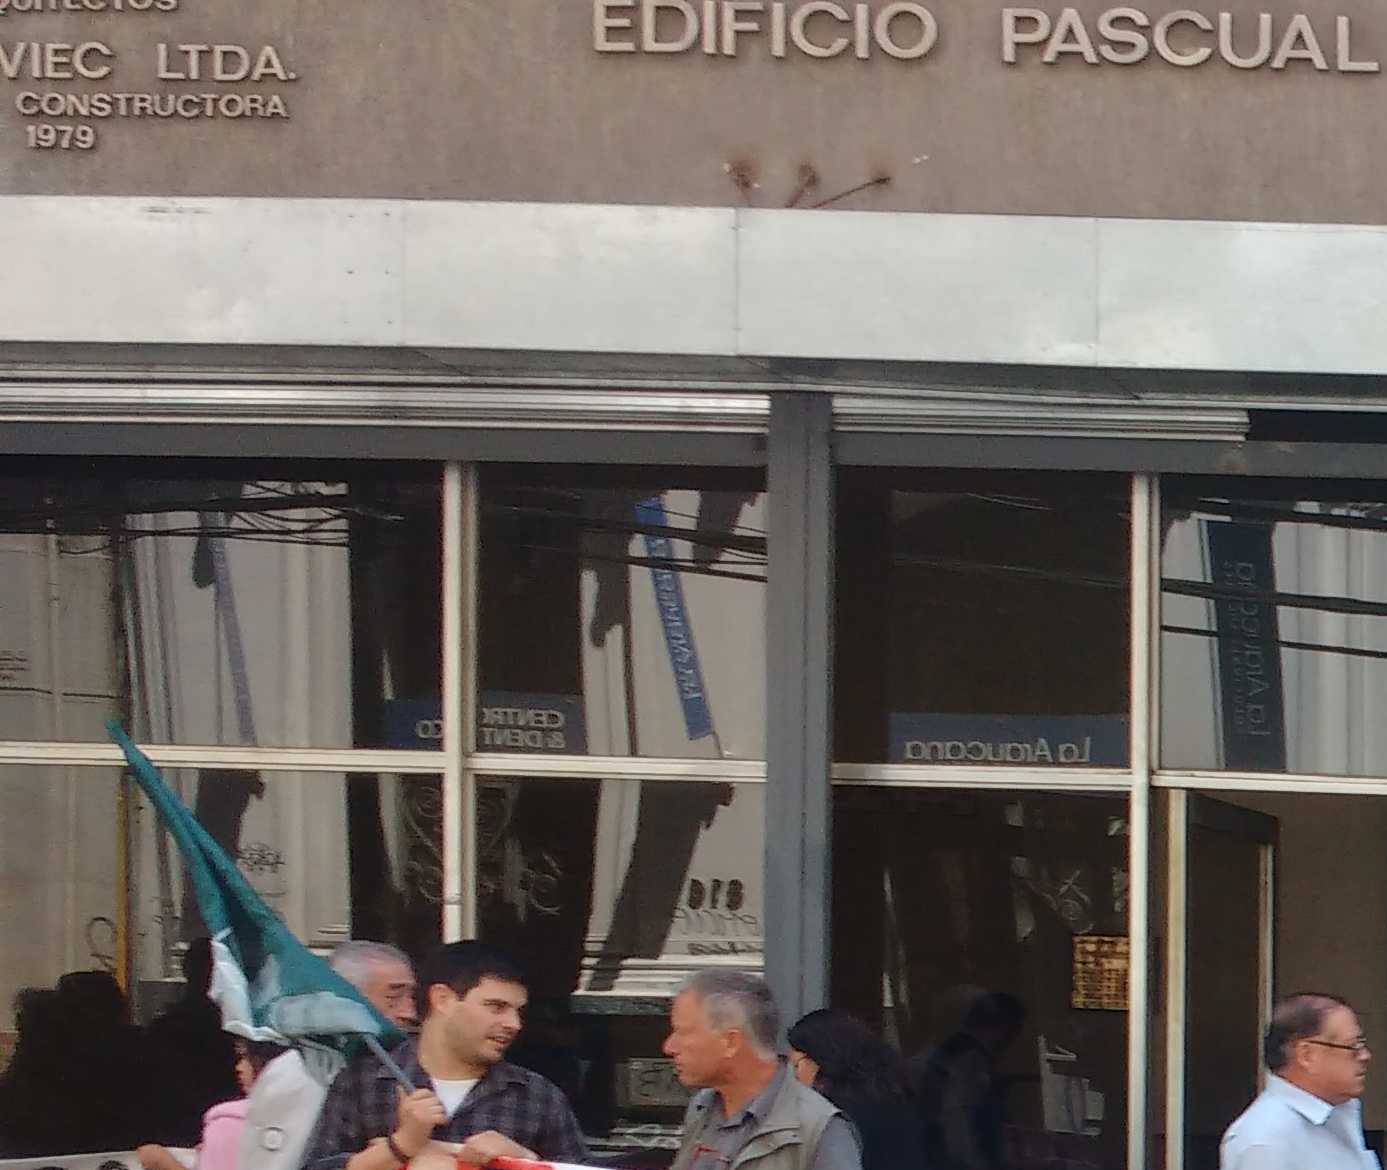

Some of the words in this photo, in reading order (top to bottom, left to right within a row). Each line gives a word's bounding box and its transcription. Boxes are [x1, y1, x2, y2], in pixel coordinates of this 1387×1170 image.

[594, 0, 938, 59] EDIFICIO
[1002, 7, 1380, 68] PASCUAL
[157, 43, 297, 82] LTDA.
[16, 91, 289, 119] CONSTRUCTORA
[26, 124, 96, 149] 1979
